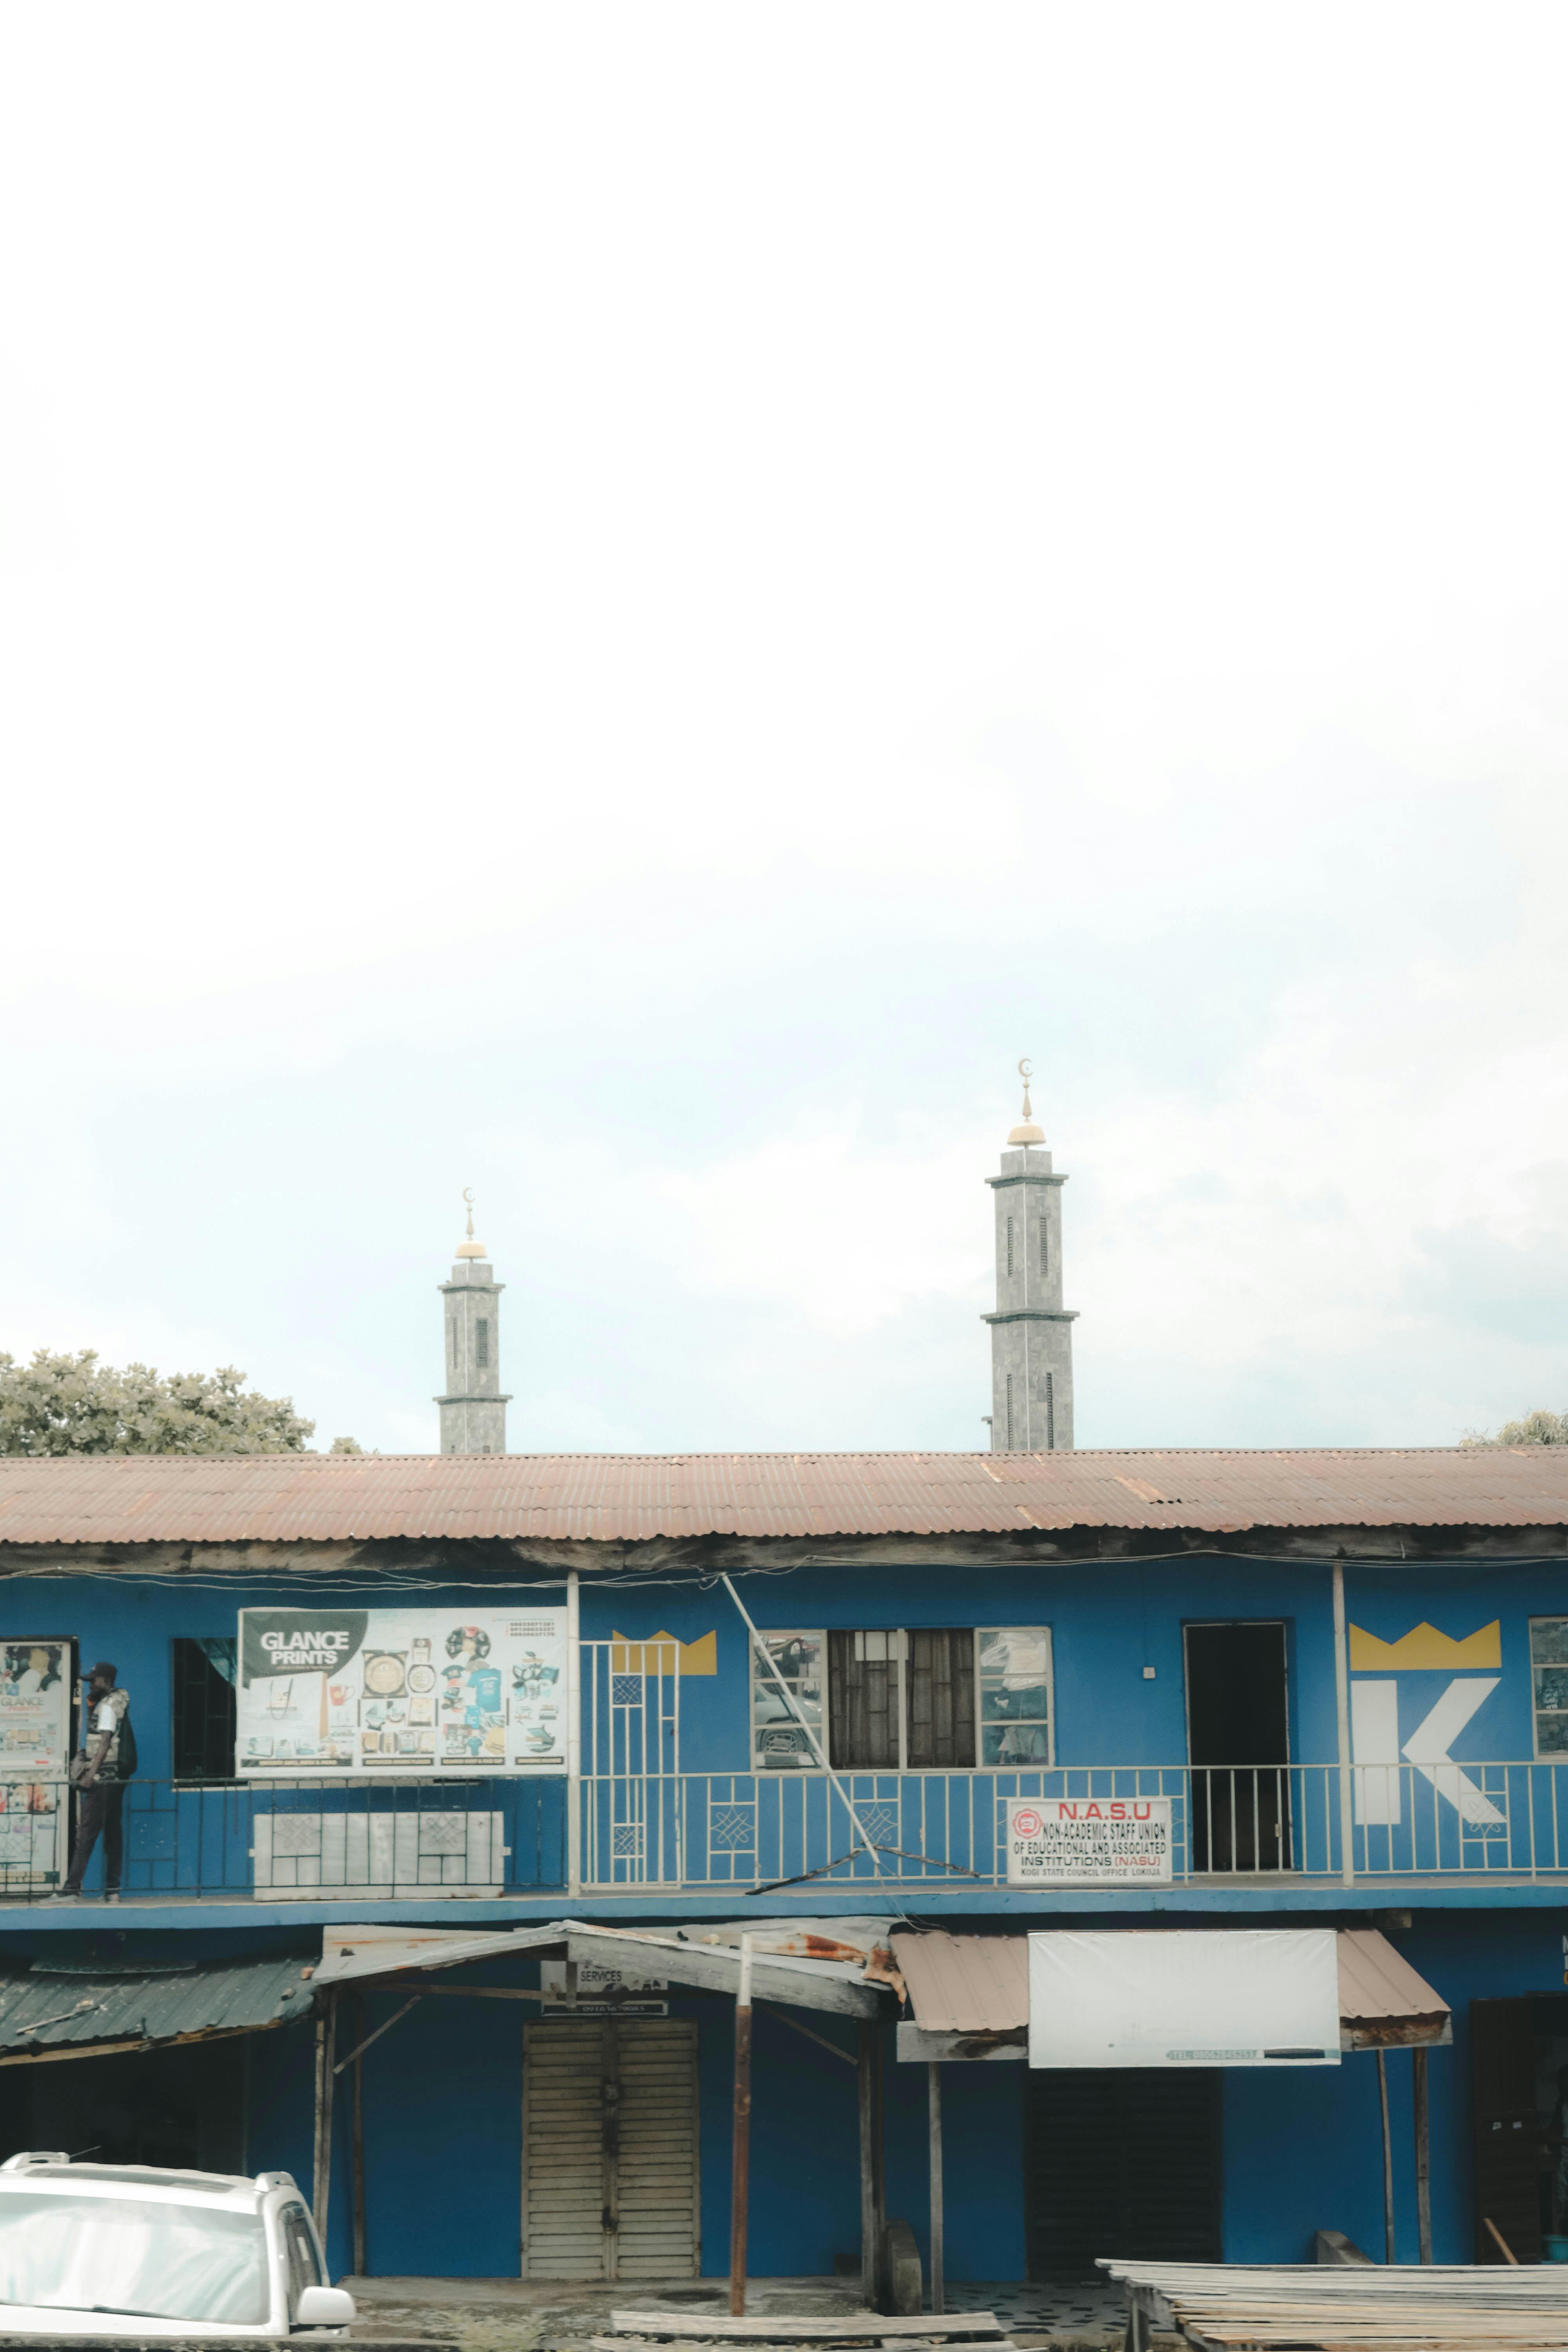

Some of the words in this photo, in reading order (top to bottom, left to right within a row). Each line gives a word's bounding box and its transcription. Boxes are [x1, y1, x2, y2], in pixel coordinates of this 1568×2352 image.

[260, 1631, 350, 1650] GLANCE
[271, 1651, 338, 1664] PRINTS
[1, 1697, 44, 1706] GLANCE
[1351, 1678, 1507, 1825] K
[1059, 1803, 1151, 1820] N.A.S.U
[1043, 1822, 1107, 1840] NON-ACADEMIC
[1110, 1822, 1135, 1839] STAFF
[1139, 1822, 1166, 1840] UNION
[1014, 1842, 1024, 1854] OF
[1028, 1842, 1088, 1855] EDUCATIONAL
[1092, 1842, 1109, 1855] AND
[1112, 1842, 1166, 1855] ASSOCIATED
[1022, 1857, 1112, 1866] INSTITUTIONS
[1115, 1857, 1160, 1866] (NASU)
[581, 1971, 622, 1982] SERVICES
